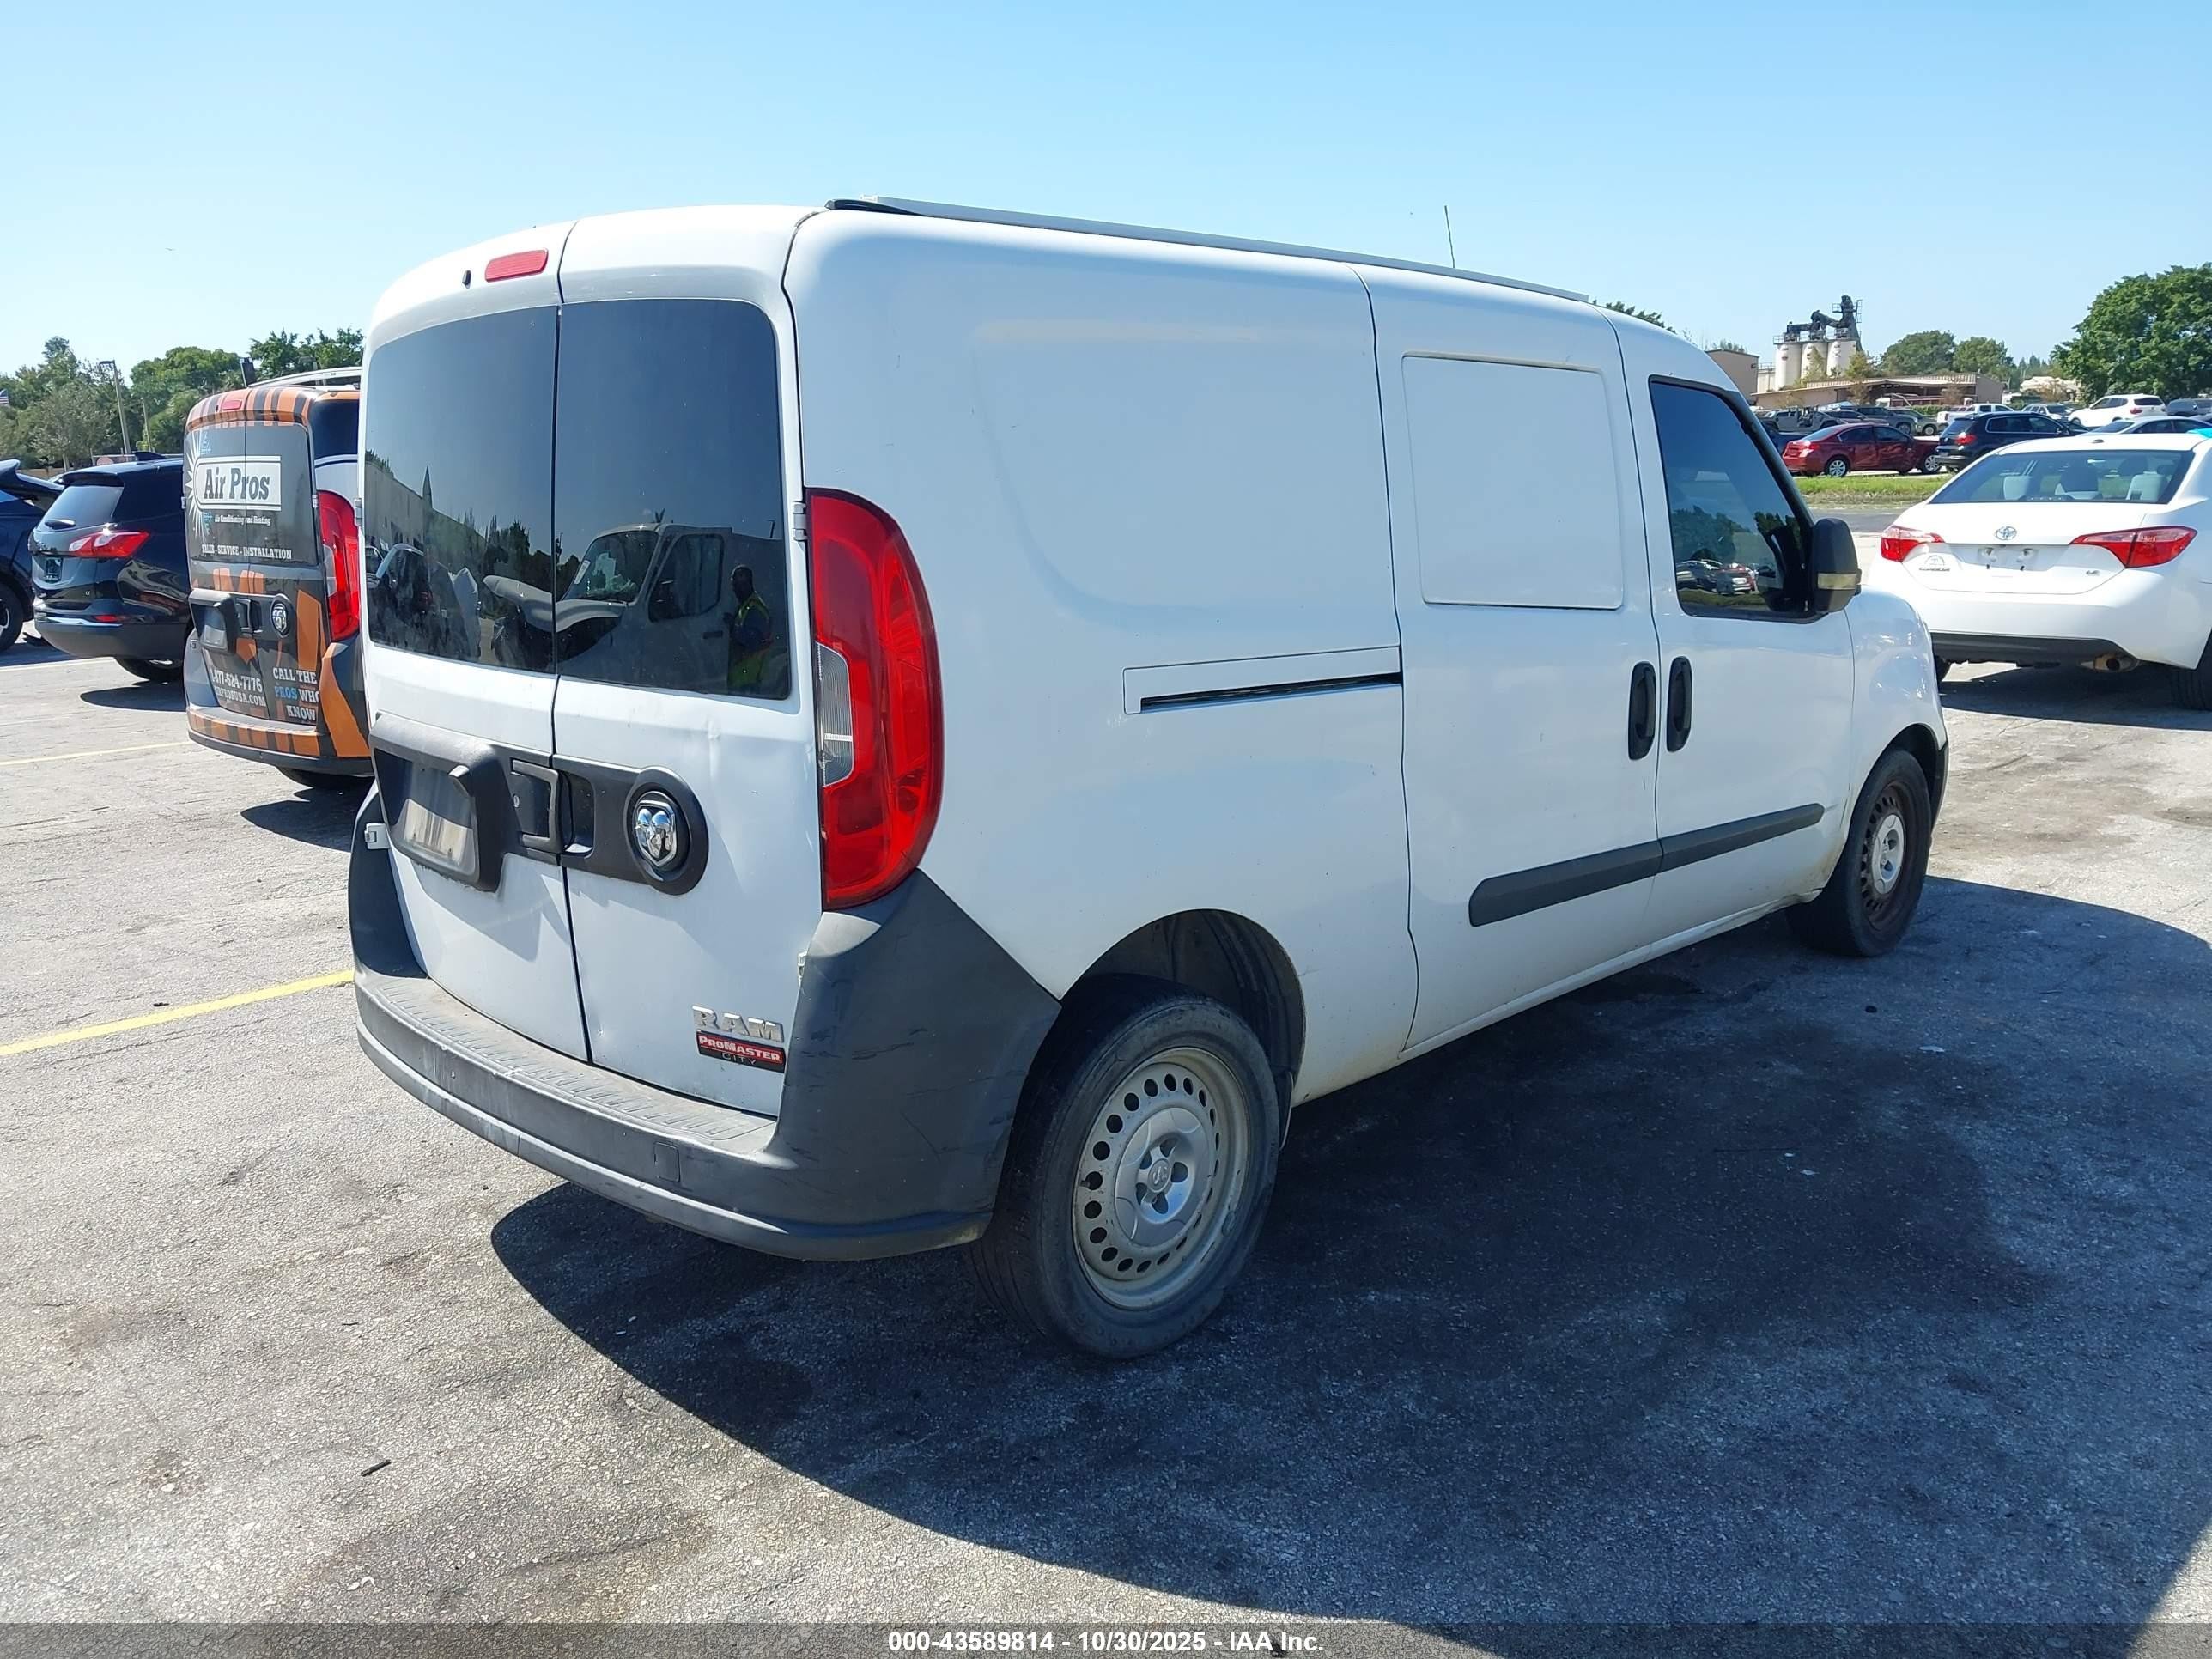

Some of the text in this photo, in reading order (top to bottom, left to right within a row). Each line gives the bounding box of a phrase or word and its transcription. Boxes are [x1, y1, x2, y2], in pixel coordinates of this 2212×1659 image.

[204, 467, 270, 501] Air Pros
[220, 514, 245, 526] Conditioning
[253, 515, 271, 526] Heating
[201, 544, 215, 555] SALES
[217, 544, 240, 556] SERVICE
[243, 546, 293, 560] INSTALLATION
[273, 667, 318, 684] CALL THE
[275, 686, 297, 700] PROS
[286, 705, 316, 721] KNOW
[691, 1005, 785, 1043] RAM
[721, 1051, 757, 1066] CITY
